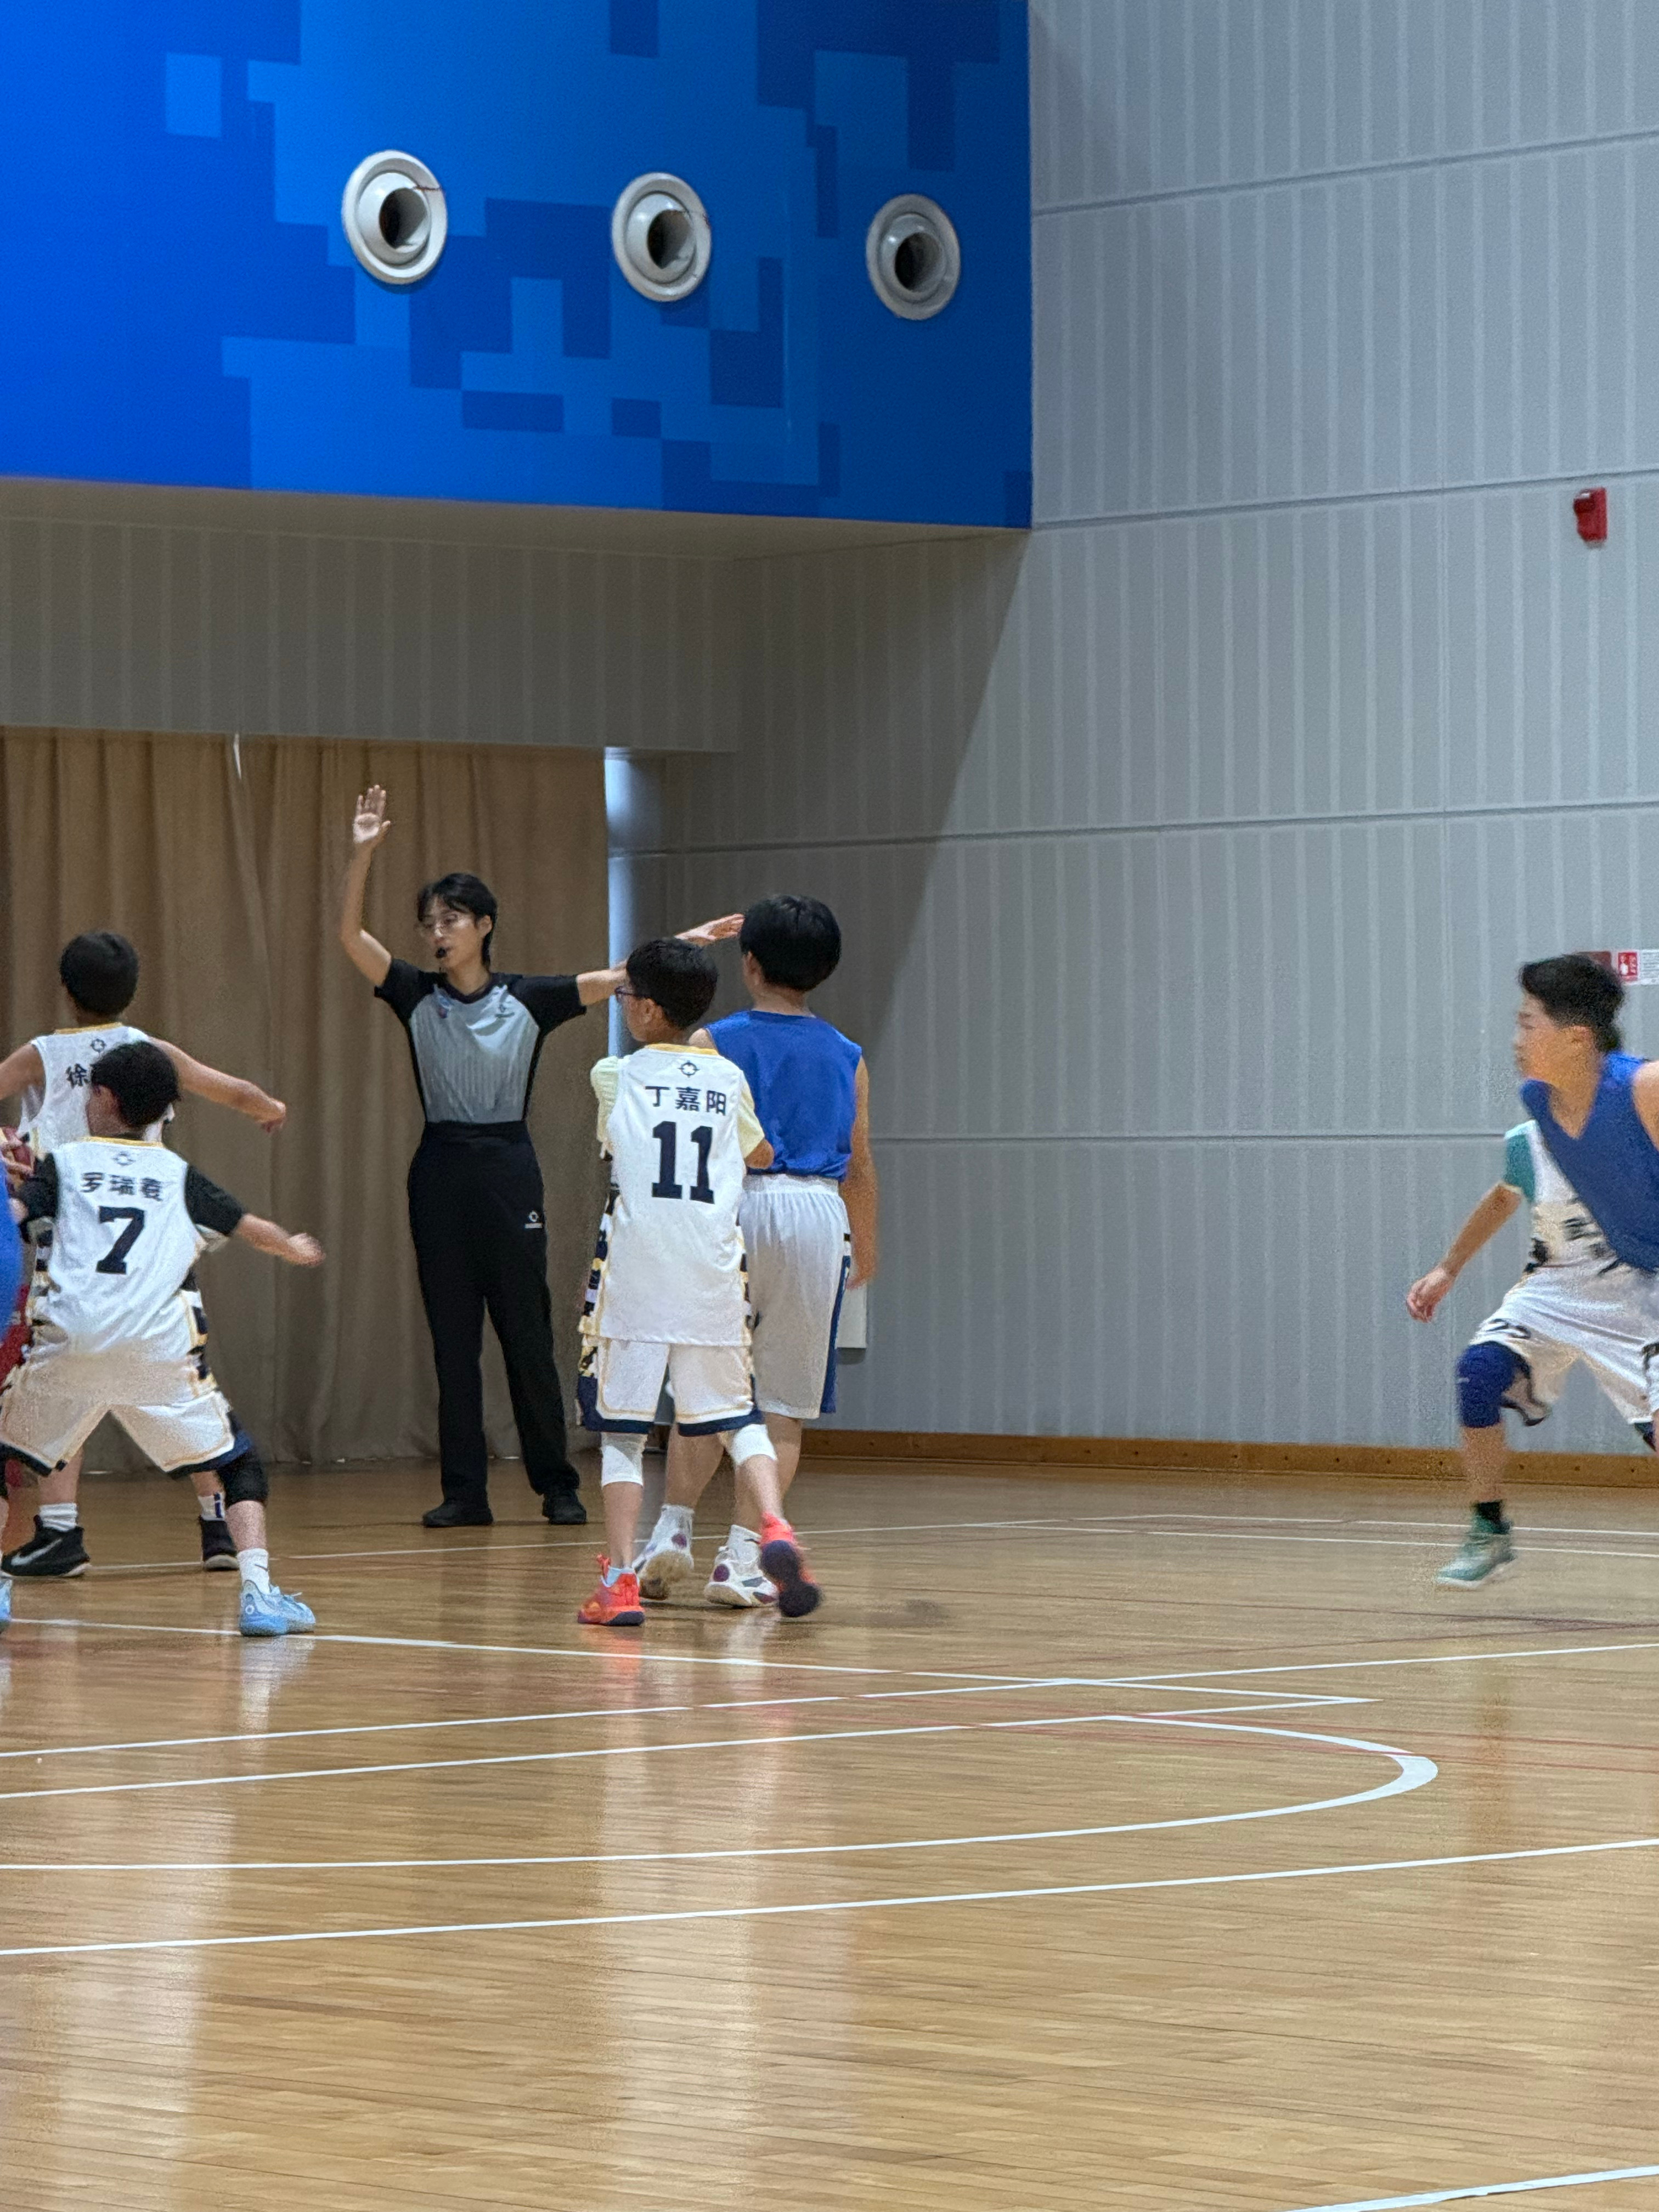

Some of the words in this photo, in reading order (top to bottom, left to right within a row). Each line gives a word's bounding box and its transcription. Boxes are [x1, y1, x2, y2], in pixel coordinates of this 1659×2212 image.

[645, 1086, 726, 1116] 丁嘉阳
[652, 1120, 715, 1204] 11
[95, 1206, 145, 1274] 7
